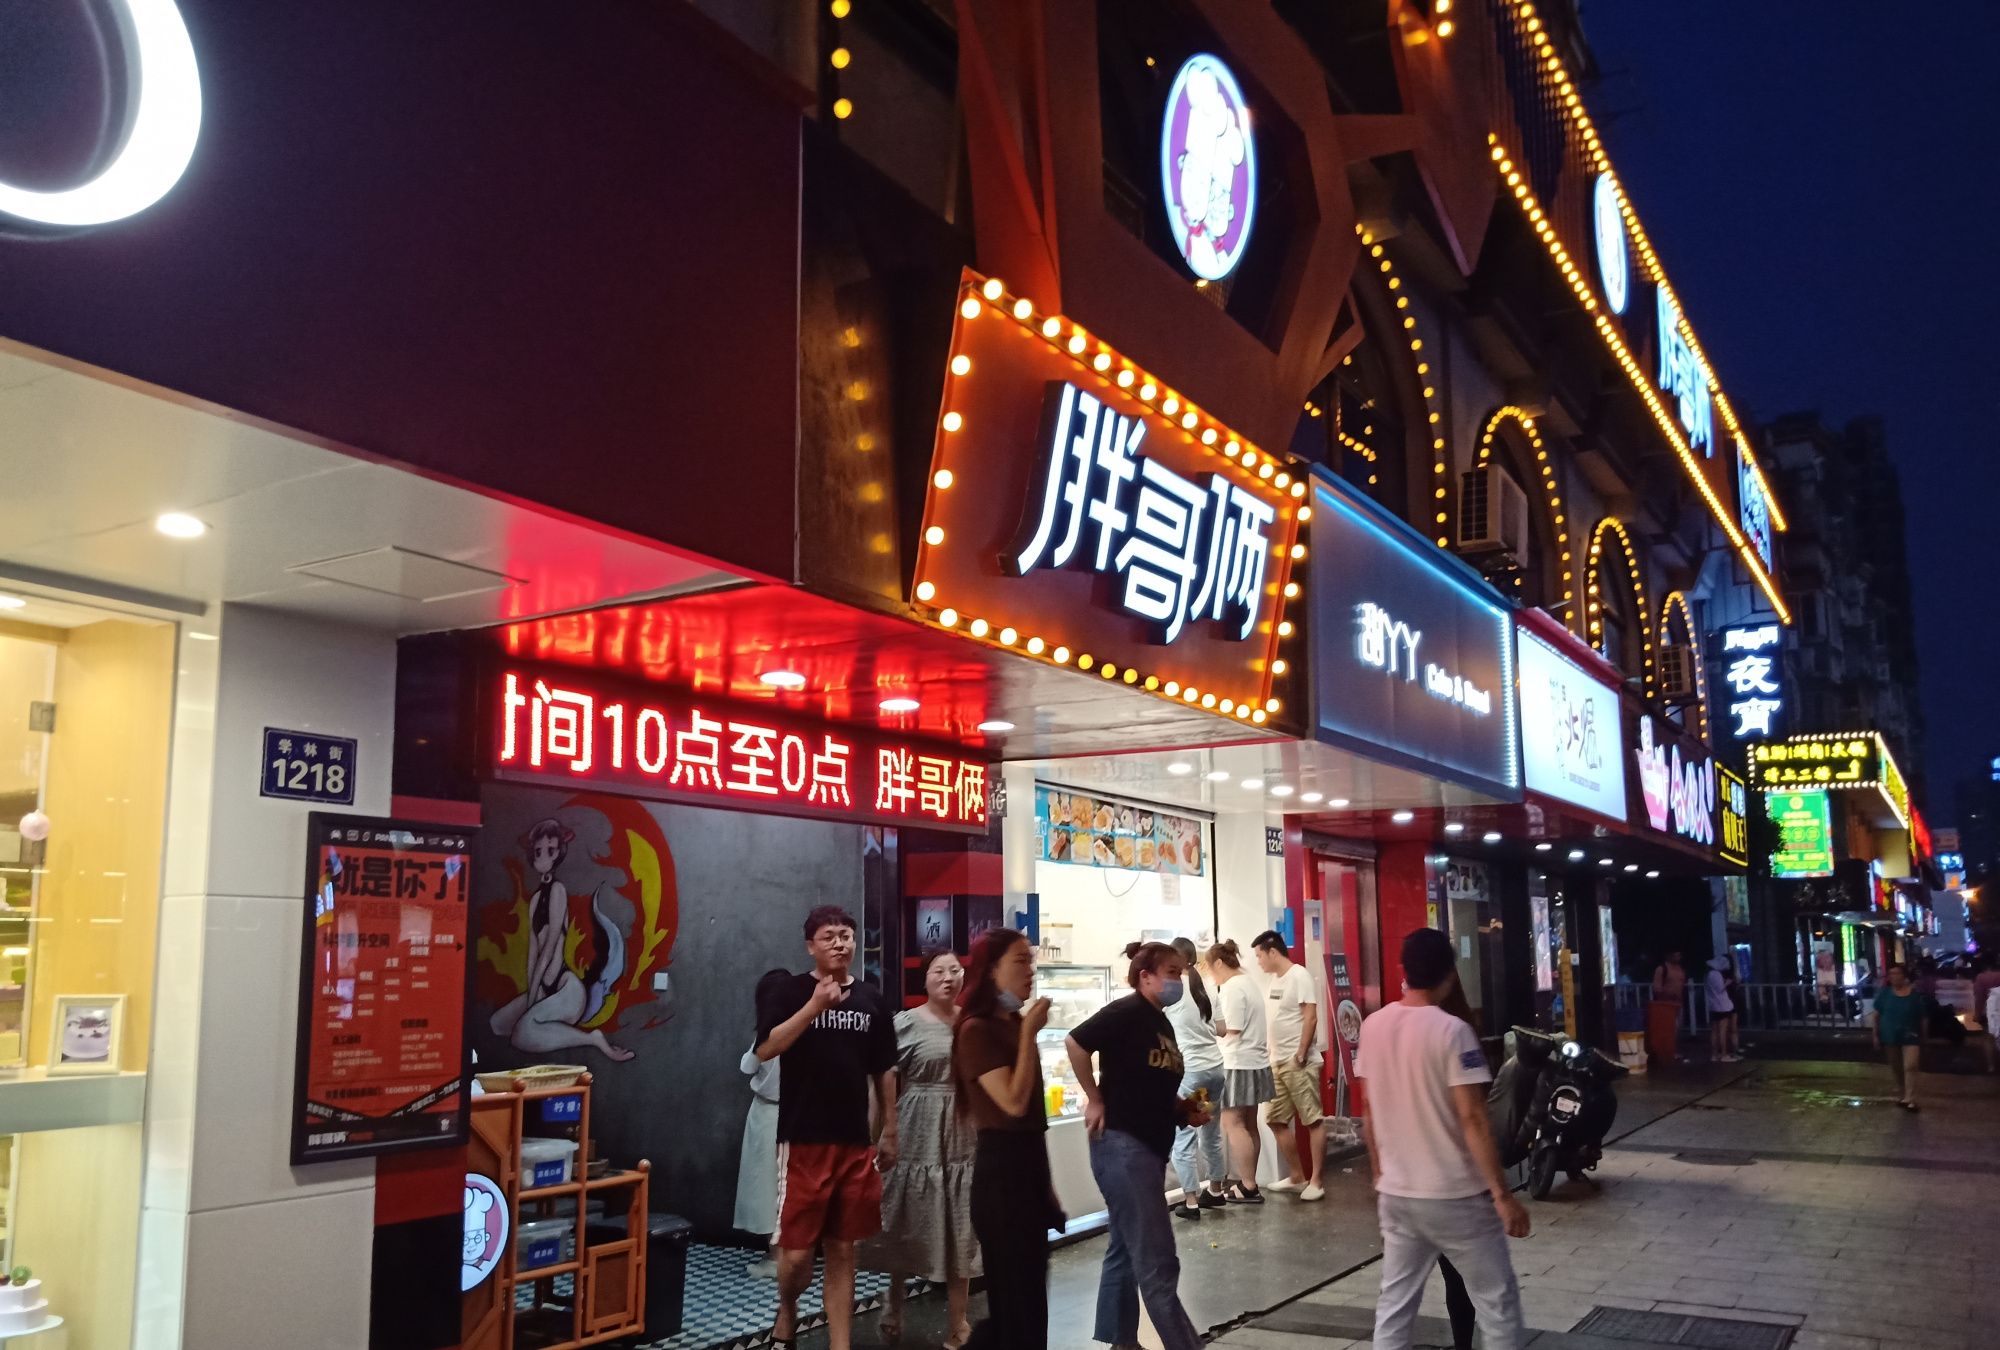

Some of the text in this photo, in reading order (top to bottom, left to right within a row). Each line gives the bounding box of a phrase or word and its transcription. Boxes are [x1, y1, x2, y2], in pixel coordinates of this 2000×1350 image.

[1017, 382, 1275, 645] 胖哥俩
[272, 758, 345, 794] 1218
[278, 738, 343, 761] 学林街
[876, 748, 985, 821] 胖哥俩
